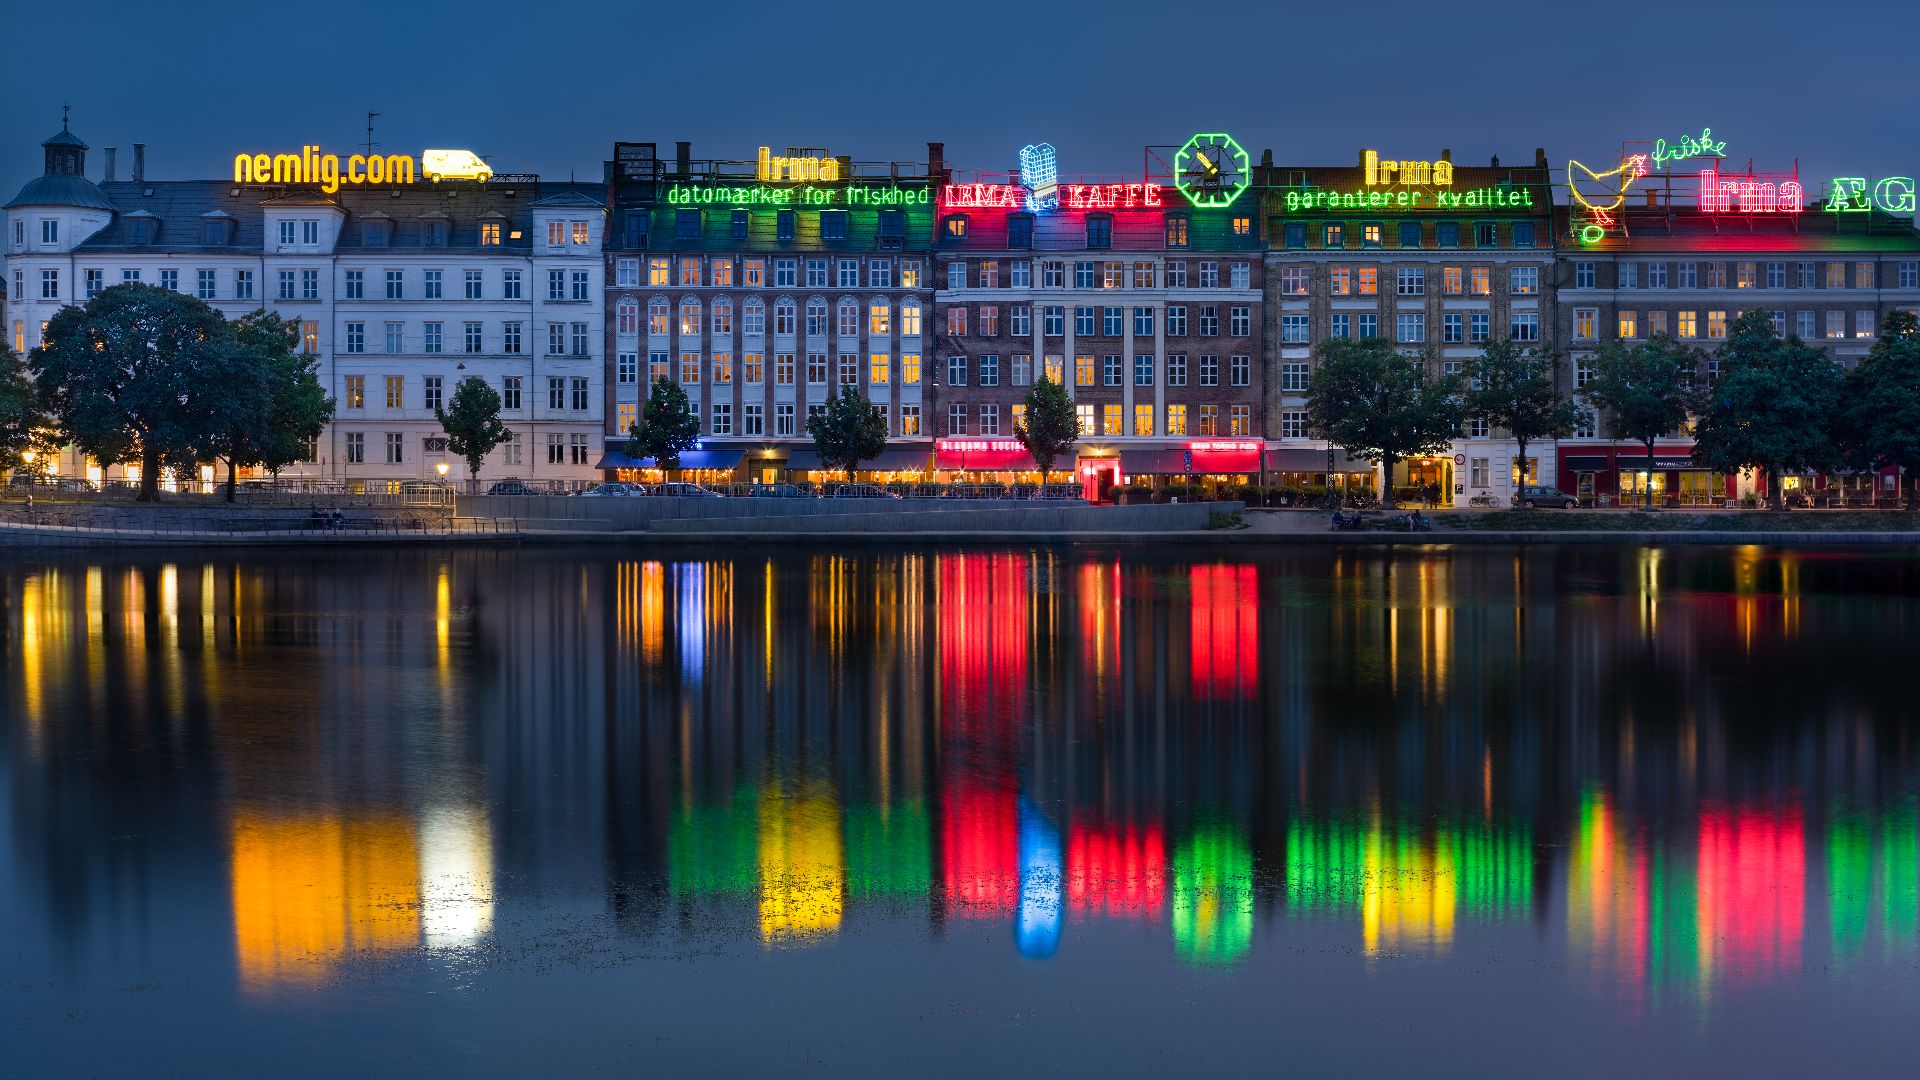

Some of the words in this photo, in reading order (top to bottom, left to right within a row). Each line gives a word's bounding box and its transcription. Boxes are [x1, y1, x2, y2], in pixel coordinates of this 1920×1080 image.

[758, 146, 839, 181] Irma
[1651, 127, 1727, 170] friske
[234, 145, 414, 194] nemlig.com
[1365, 150, 1453, 185] Irma
[668, 184, 794, 206] datomærker
[804, 185, 836, 206] for
[846, 184, 929, 206] friskhed
[945, 184, 1018, 208] IRMA
[1068, 184, 1162, 207] KAFFE
[1286, 189, 1422, 211] garanterer
[1437, 187, 1533, 208] kvalitet
[1701, 169, 1802, 212] Irma
[1825, 176, 1916, 212] ÆG
